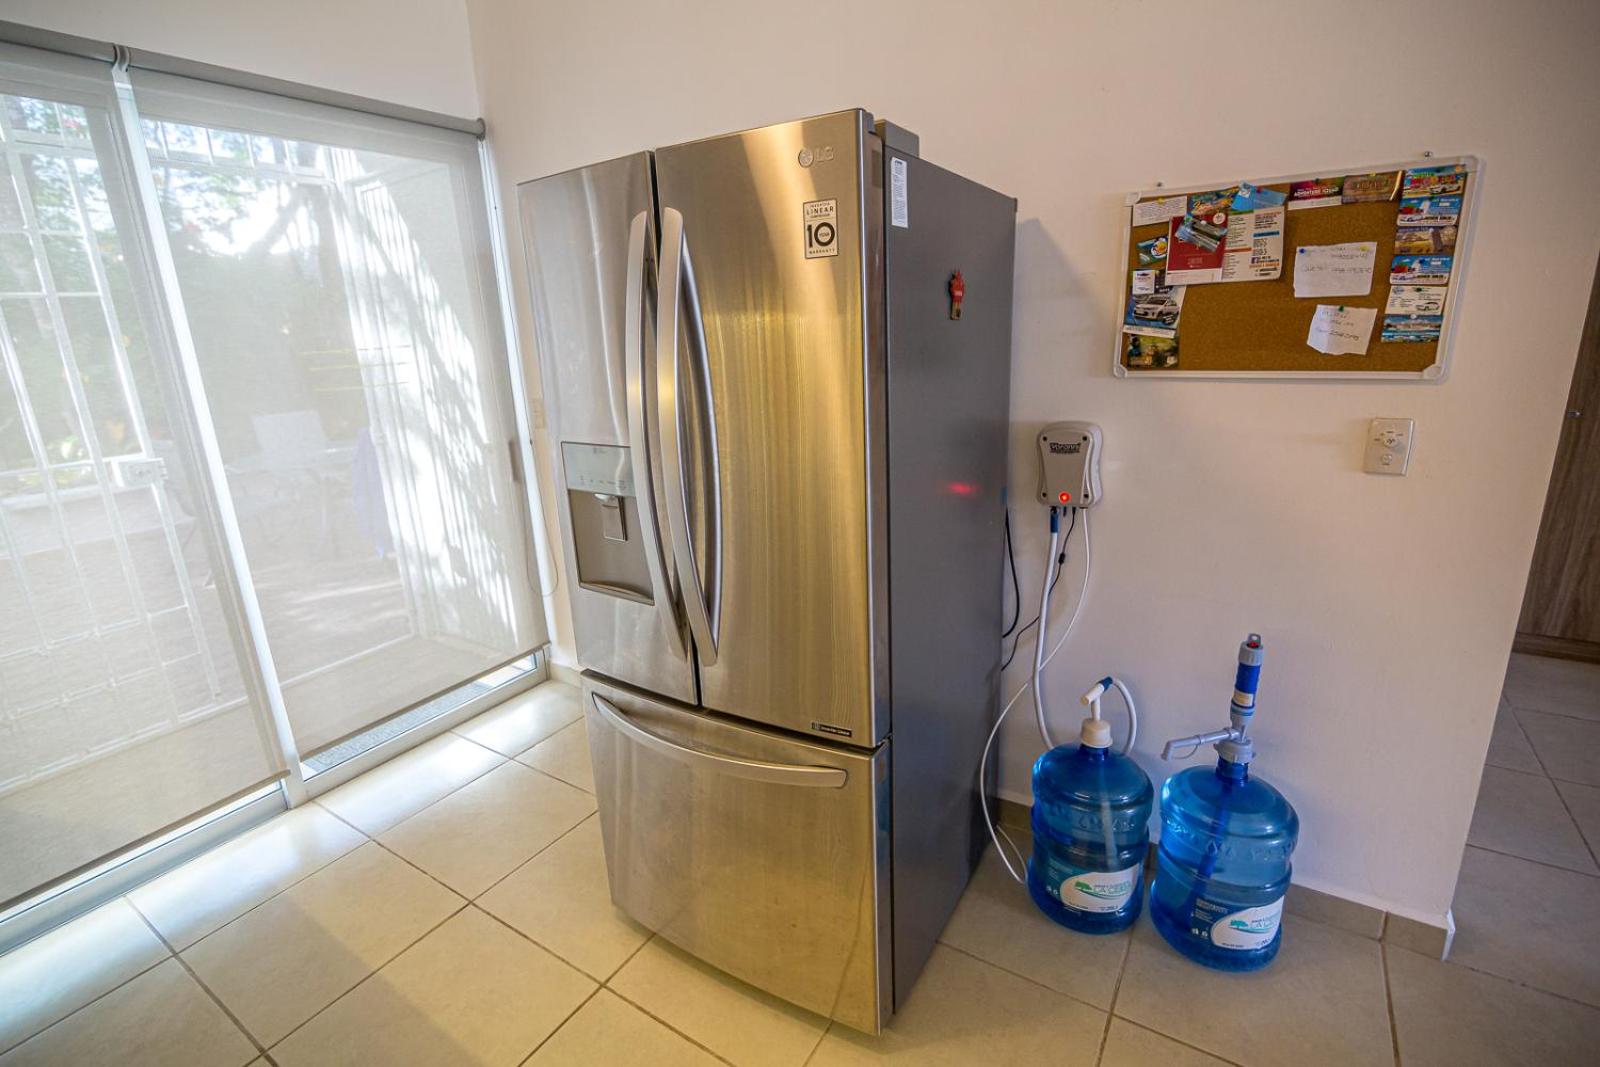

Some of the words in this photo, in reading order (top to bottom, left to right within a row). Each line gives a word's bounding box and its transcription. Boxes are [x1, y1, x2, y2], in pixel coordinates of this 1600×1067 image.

[815, 146, 833, 162] LG
[806, 206, 834, 216] LINEAR
[807, 222, 835, 248] 10
